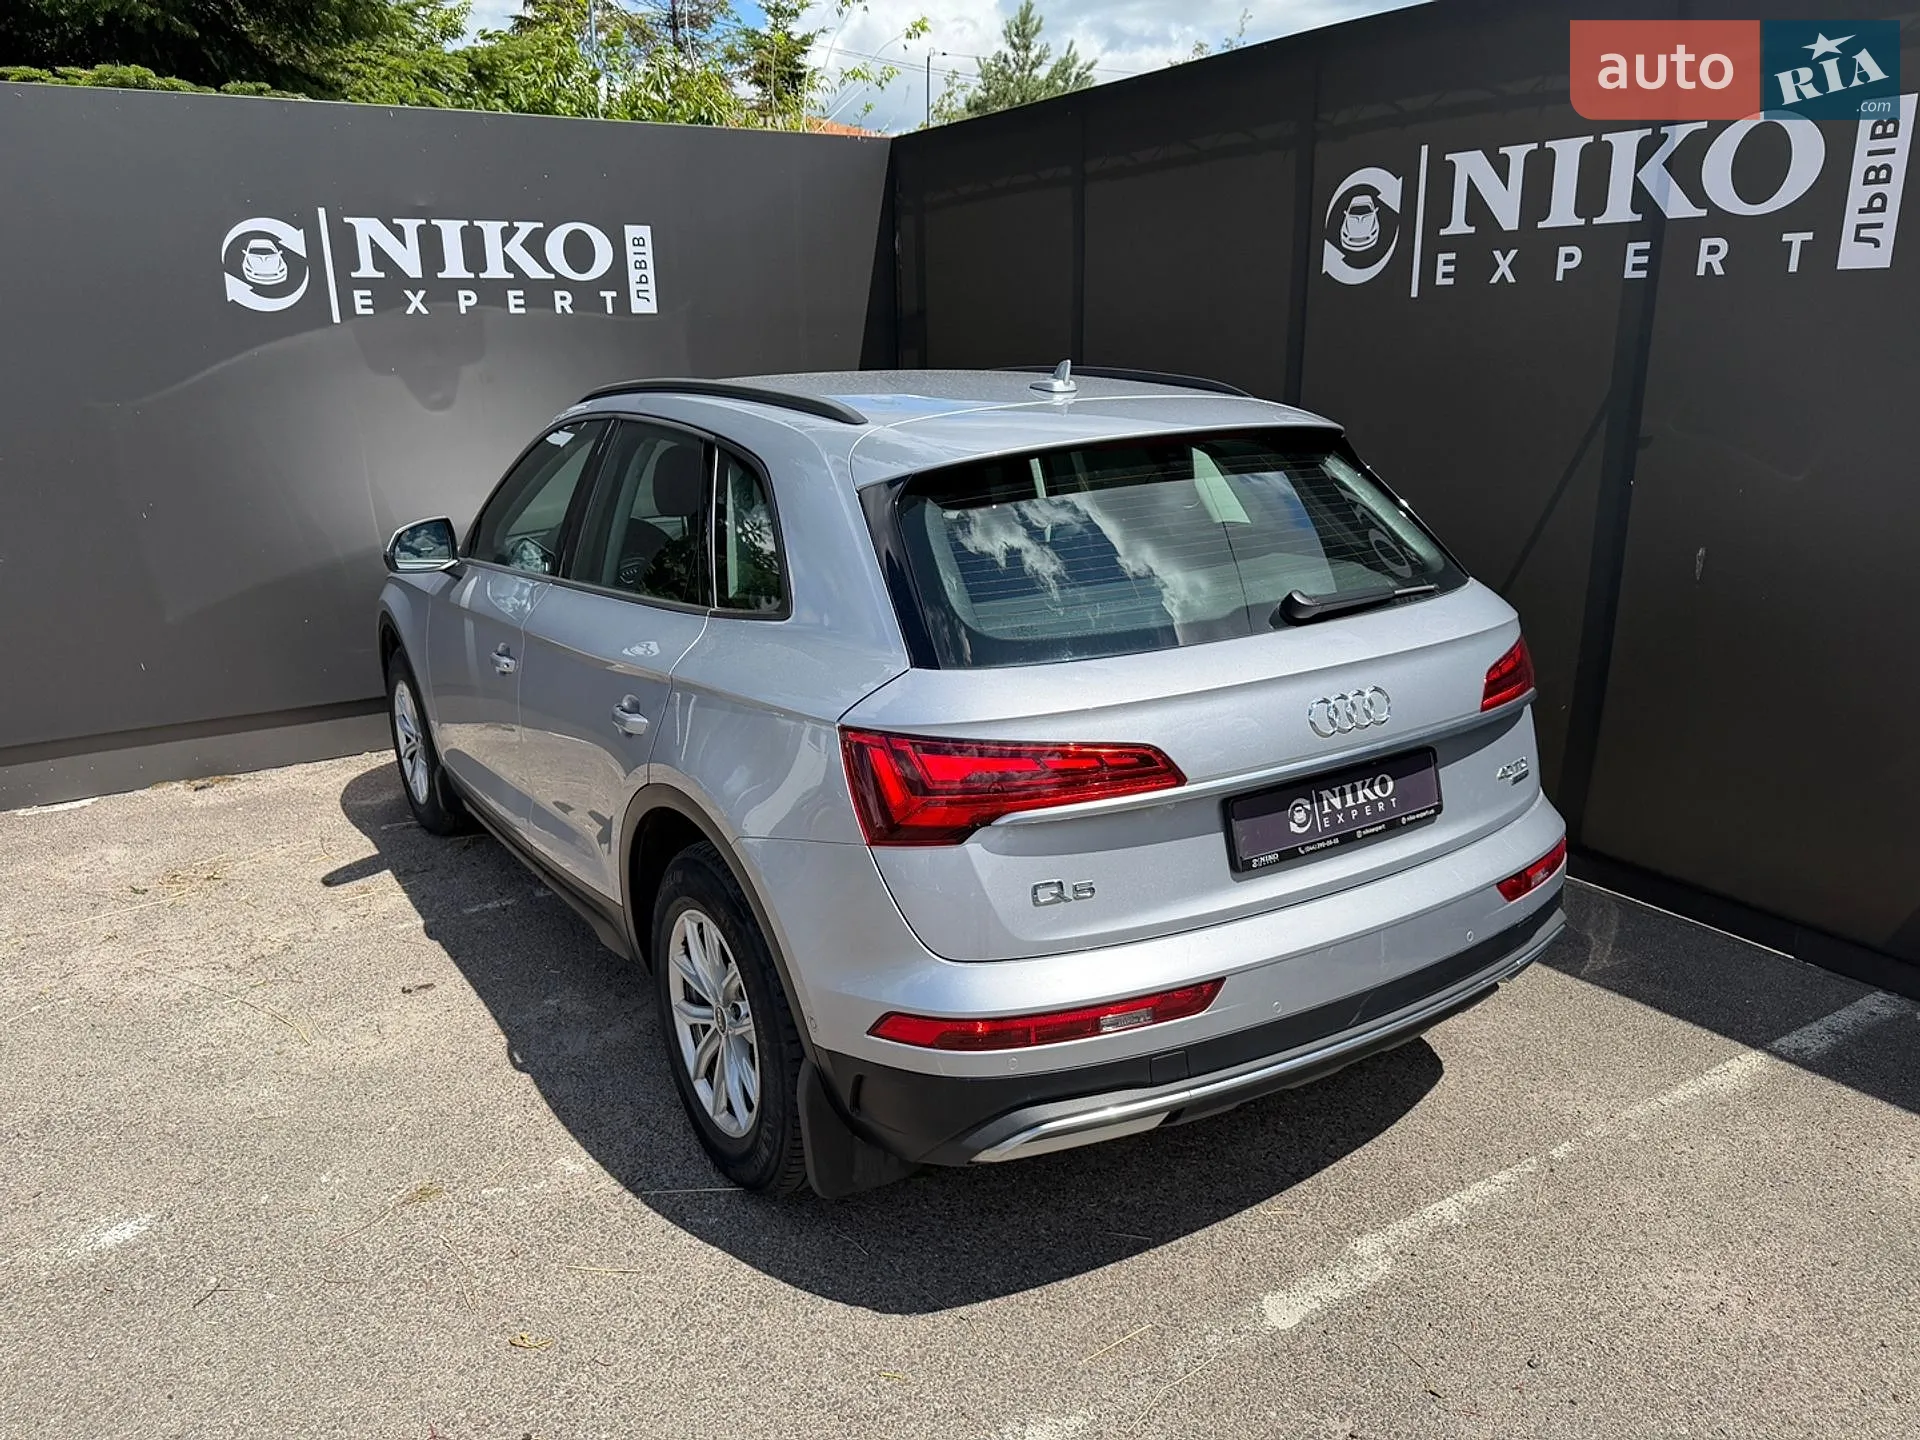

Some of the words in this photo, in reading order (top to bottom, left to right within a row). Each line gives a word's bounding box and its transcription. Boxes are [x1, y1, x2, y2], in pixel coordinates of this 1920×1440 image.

[1439, 110, 1826, 237] NIKO
[1853, 118, 1900, 249] ЛЬВІВ
[343, 217, 614, 282] NIKO
[632, 236, 650, 303] ЛЬВІВ
[1435, 231, 1813, 286] EXPERT
[354, 290, 617, 315] EXPERT
[1319, 773, 1394, 813] NIKO
[1323, 798, 1397, 827] EXPERT
[1031, 879, 1096, 908] Q5
